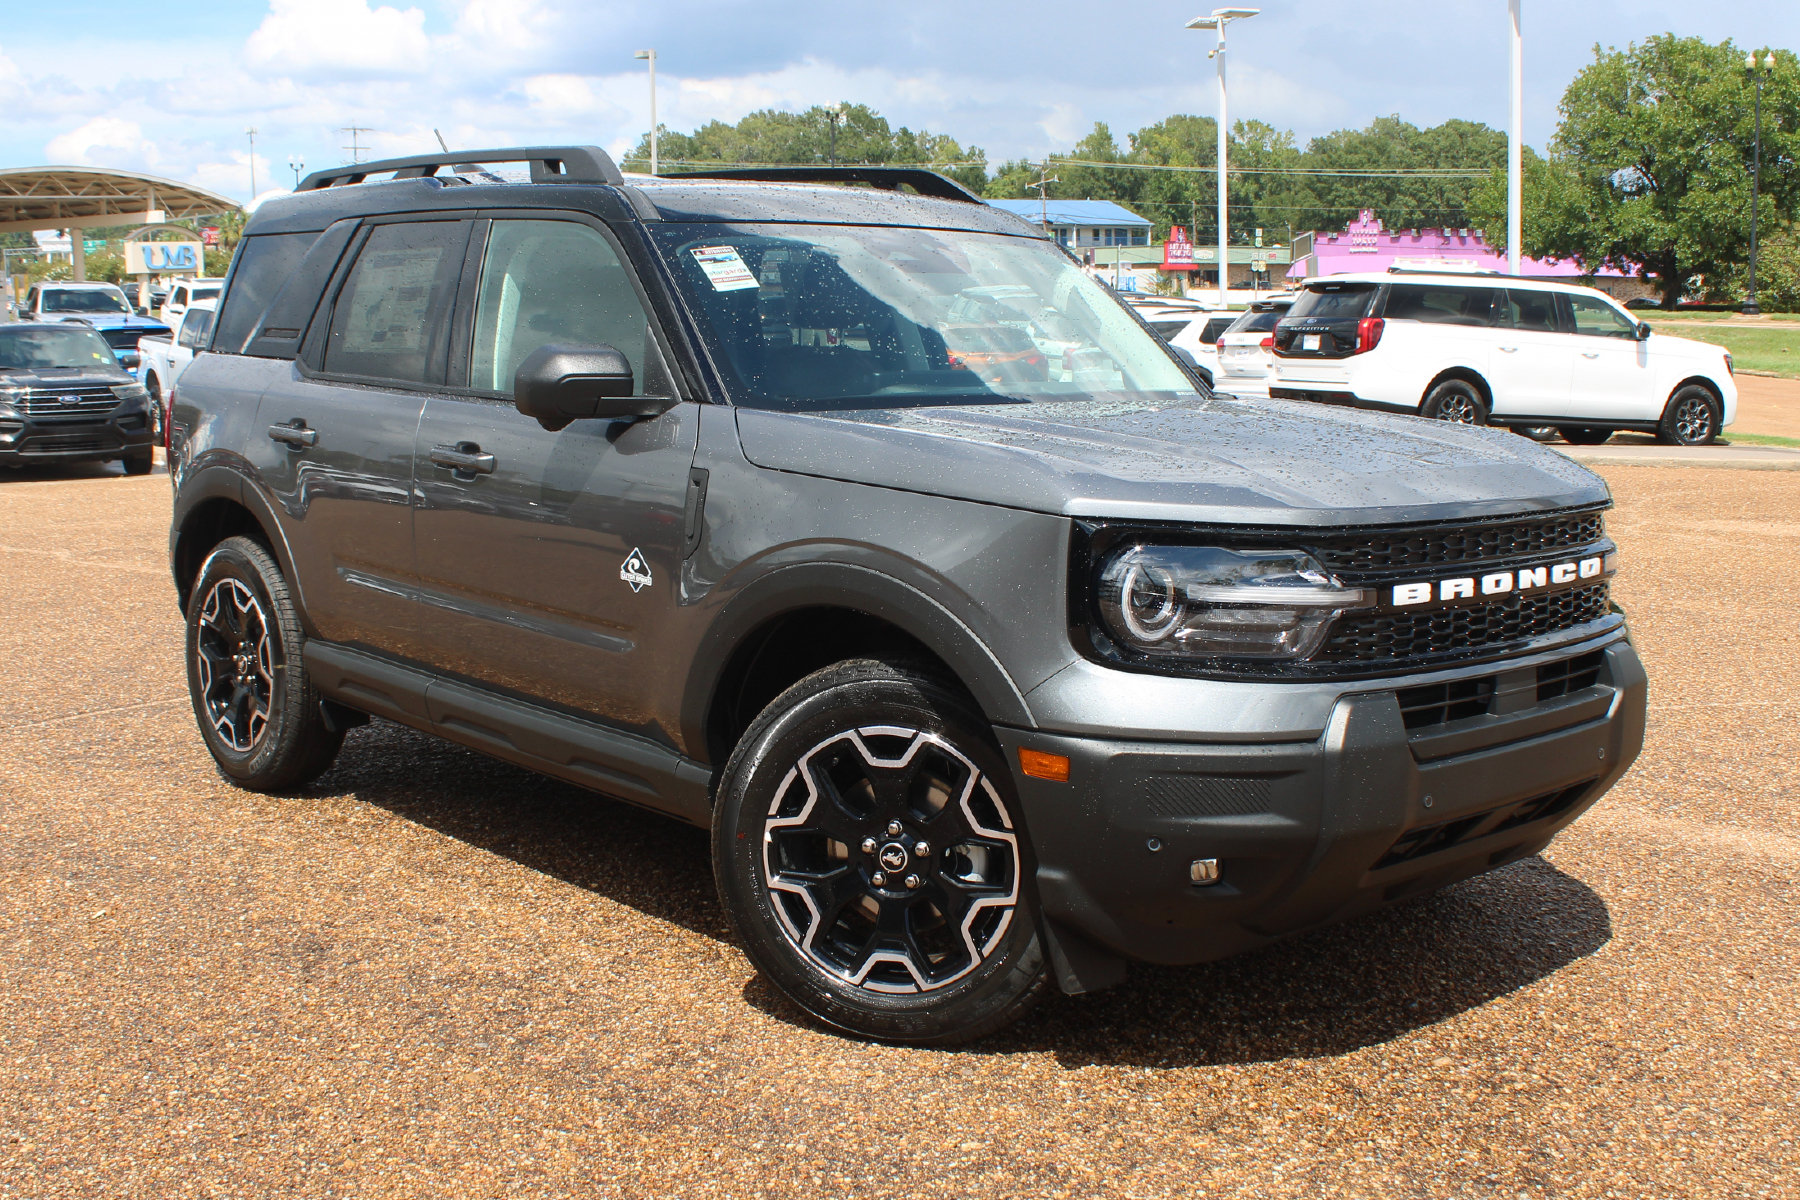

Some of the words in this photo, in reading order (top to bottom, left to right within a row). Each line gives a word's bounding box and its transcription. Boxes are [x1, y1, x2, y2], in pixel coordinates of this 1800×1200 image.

[141, 245, 197, 270] UMB
[1169, 242, 1191, 250] LITTLE
[1392, 557, 1602, 606] BRONCO
